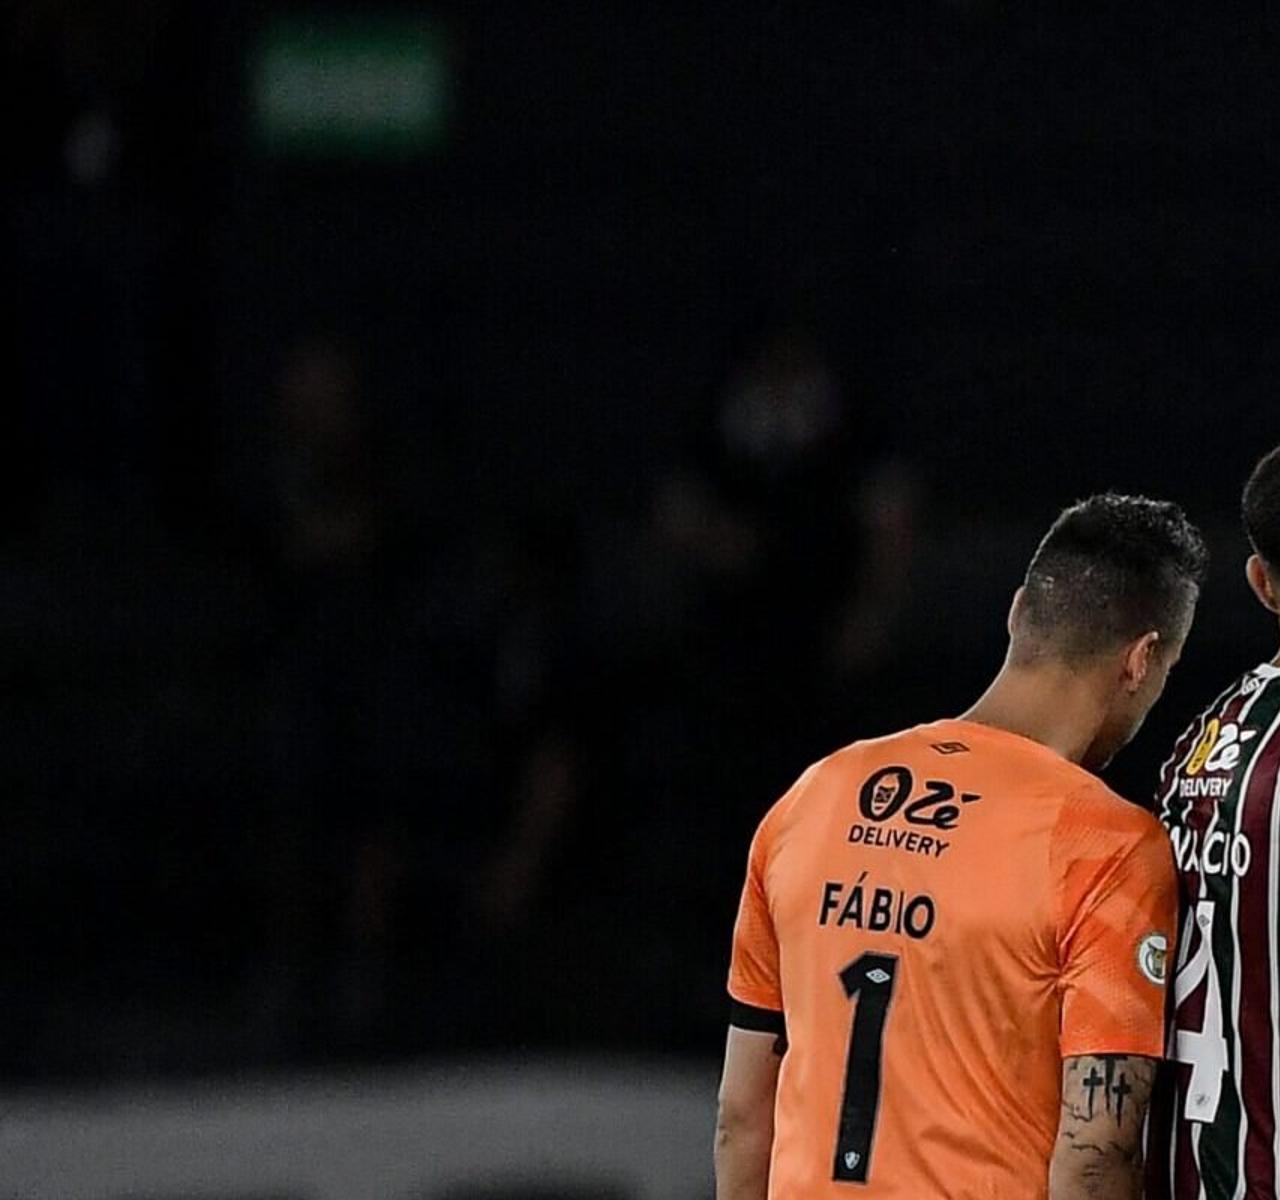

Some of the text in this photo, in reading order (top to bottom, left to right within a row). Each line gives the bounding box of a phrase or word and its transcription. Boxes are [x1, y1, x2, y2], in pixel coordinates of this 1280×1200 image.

[1179, 776, 1233, 798] DELIVERY
[848, 824, 950, 859] DELIVERY
[818, 871, 936, 940] FÁBIO
[1175, 900, 1230, 1124] 4
[831, 950, 899, 1185] 1
